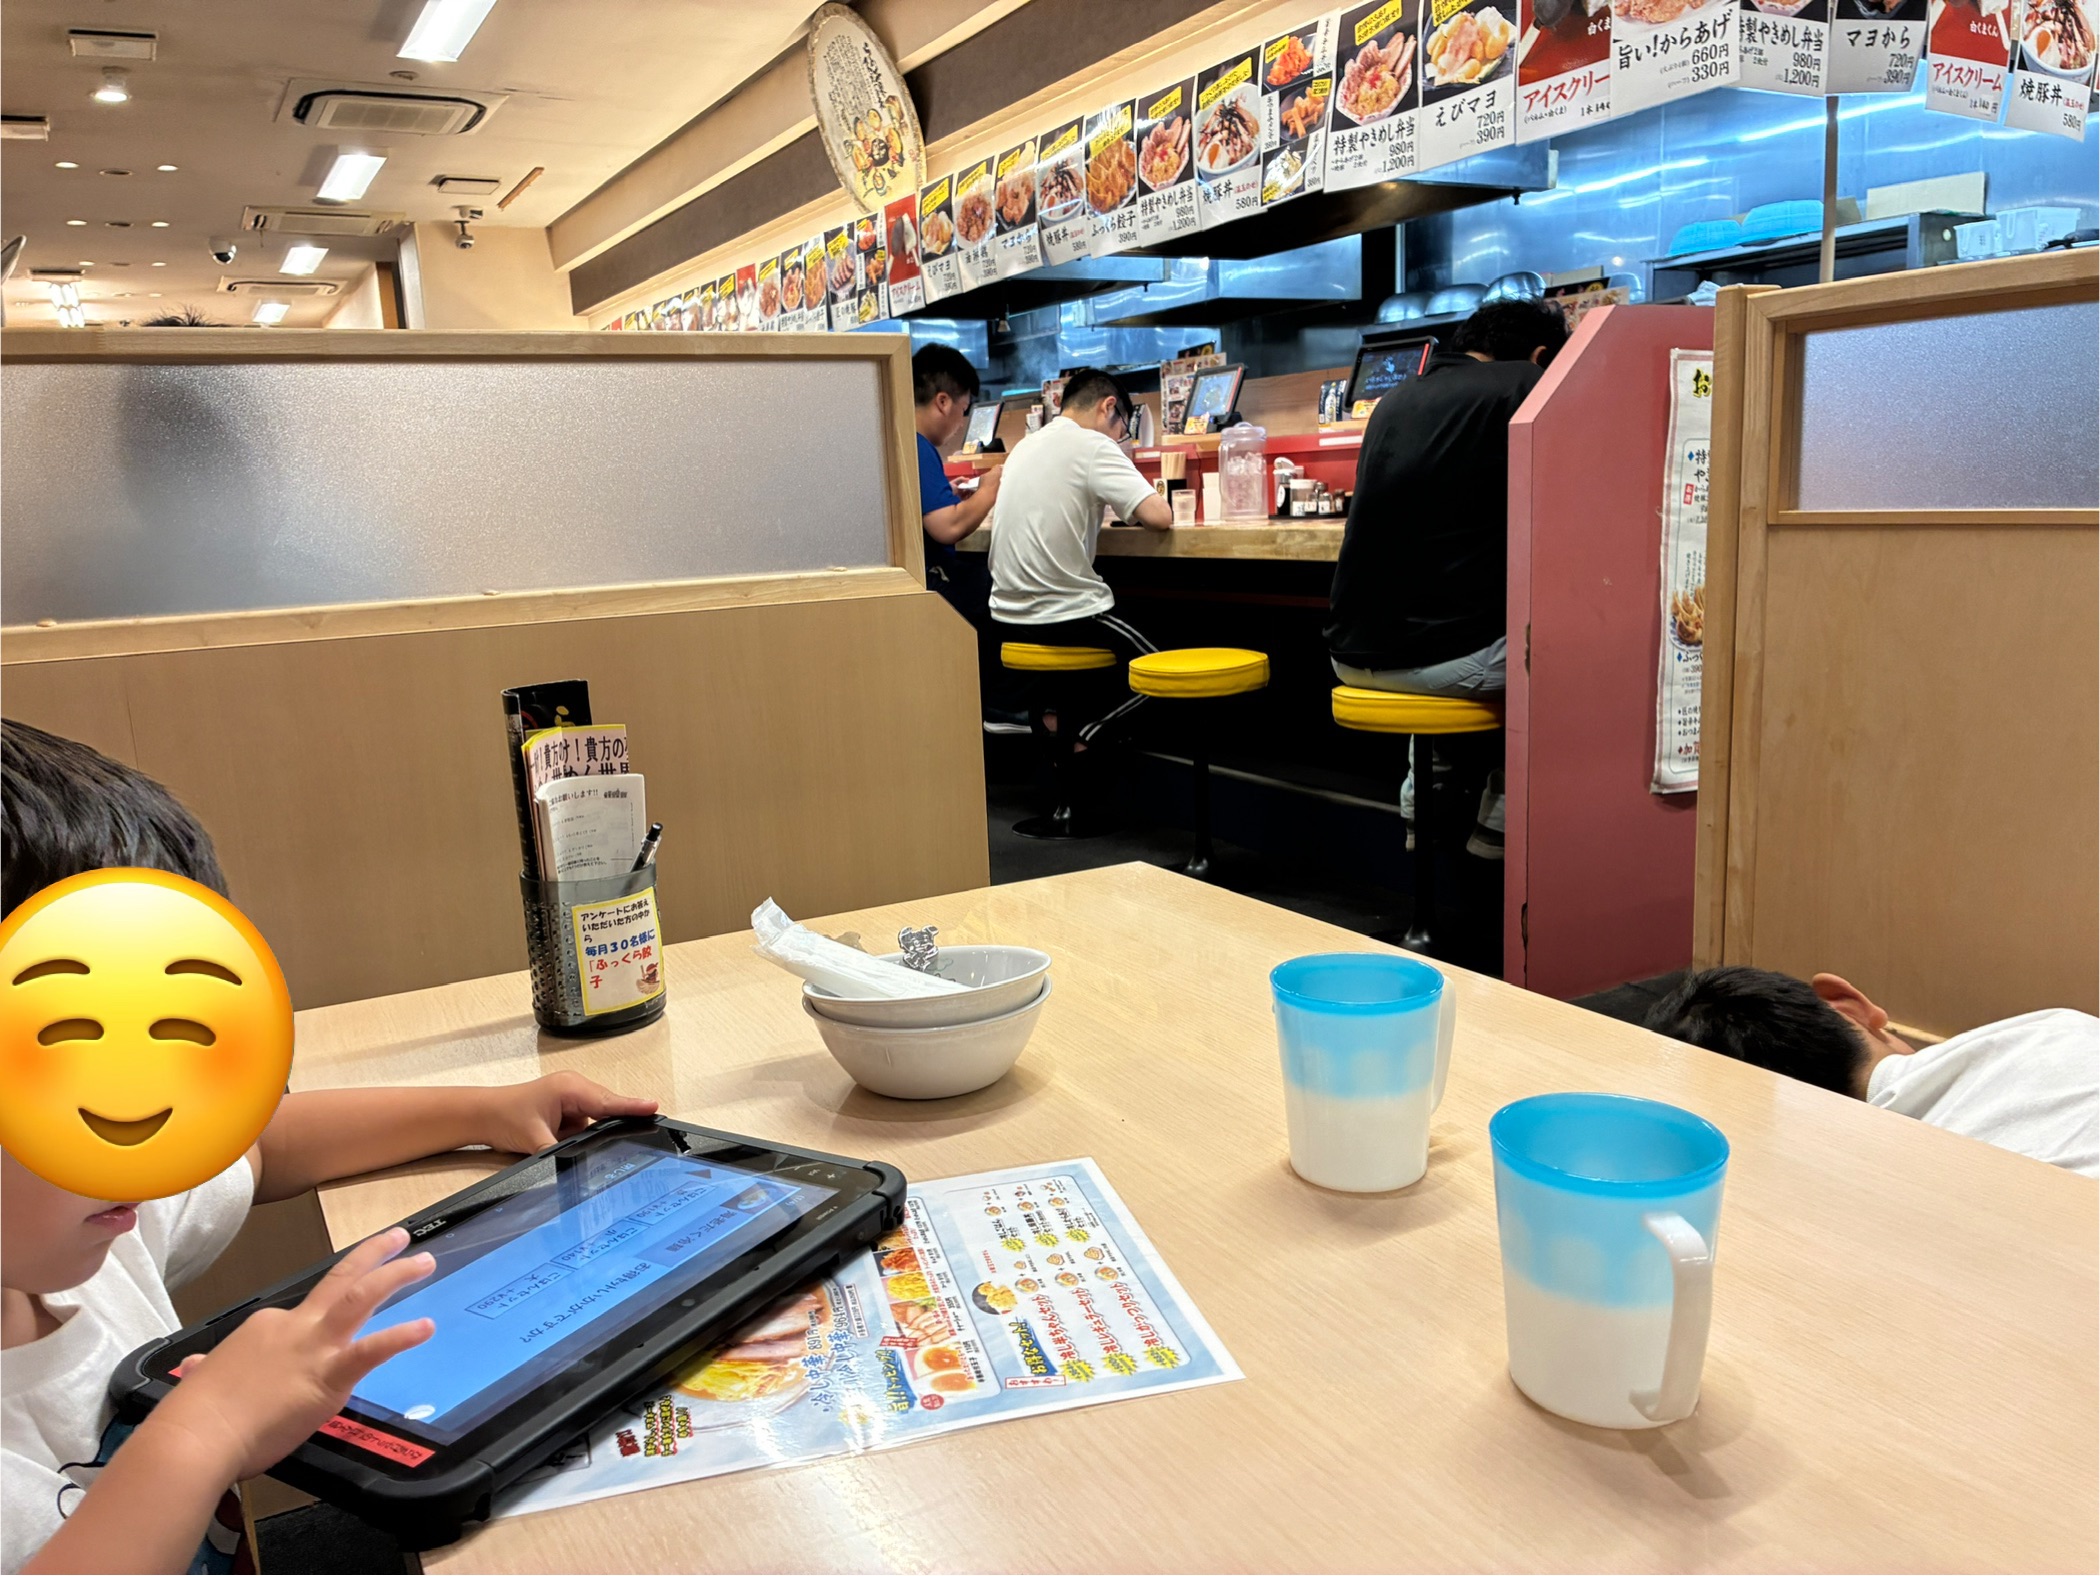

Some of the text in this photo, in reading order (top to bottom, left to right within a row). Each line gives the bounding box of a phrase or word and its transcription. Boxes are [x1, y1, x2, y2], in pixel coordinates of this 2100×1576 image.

[1618, 8, 1734, 70] 旨い!からあげ
[1847, 25, 1911, 50] マヨから
[1692, 43, 1729, 64] 660円
[1792, 52, 1821, 72] 980円
[1889, 53, 1915, 69] 720円
[1692, 61, 1730, 83] 330円
[1783, 68, 1820, 88] 1,200円
[1932, 62, 2003, 92] アイスクリーム
[1523, 71, 1610, 114] アイスクリー
[2020, 78, 2063, 107] 焼豚丼
[1435, 90, 1497, 127] えびマヨ
[1477, 110, 1505, 128] 720円
[1333, 115, 1415, 157] 特製やきめし弁当
[1476, 125, 1505, 145] 390円
[581, 898, 649, 922] アンケートにお答え
[582, 910, 650, 932] いただいた方の中か
[584, 934, 593, 943] ら
[585, 929, 656, 957] 毎月30名様に
[589, 975, 603, 989] 子
[413, 1218, 448, 1240] TEC
[580, 1226, 638, 1262] ごはんセット
[477, 1287, 517, 1310] +¥290
[498, 1271, 561, 1309] ごはんセット
[1032, 1294, 1078, 1360] 冷し半ちゃんセット
[1072, 1287, 1122, 1354] 冷しレギュラーセット
[1110, 1281, 1163, 1348] 冷しがっつりセット
[807, 1324, 823, 1351] 891円
[801, 1354, 836, 1403] 冷し中華
